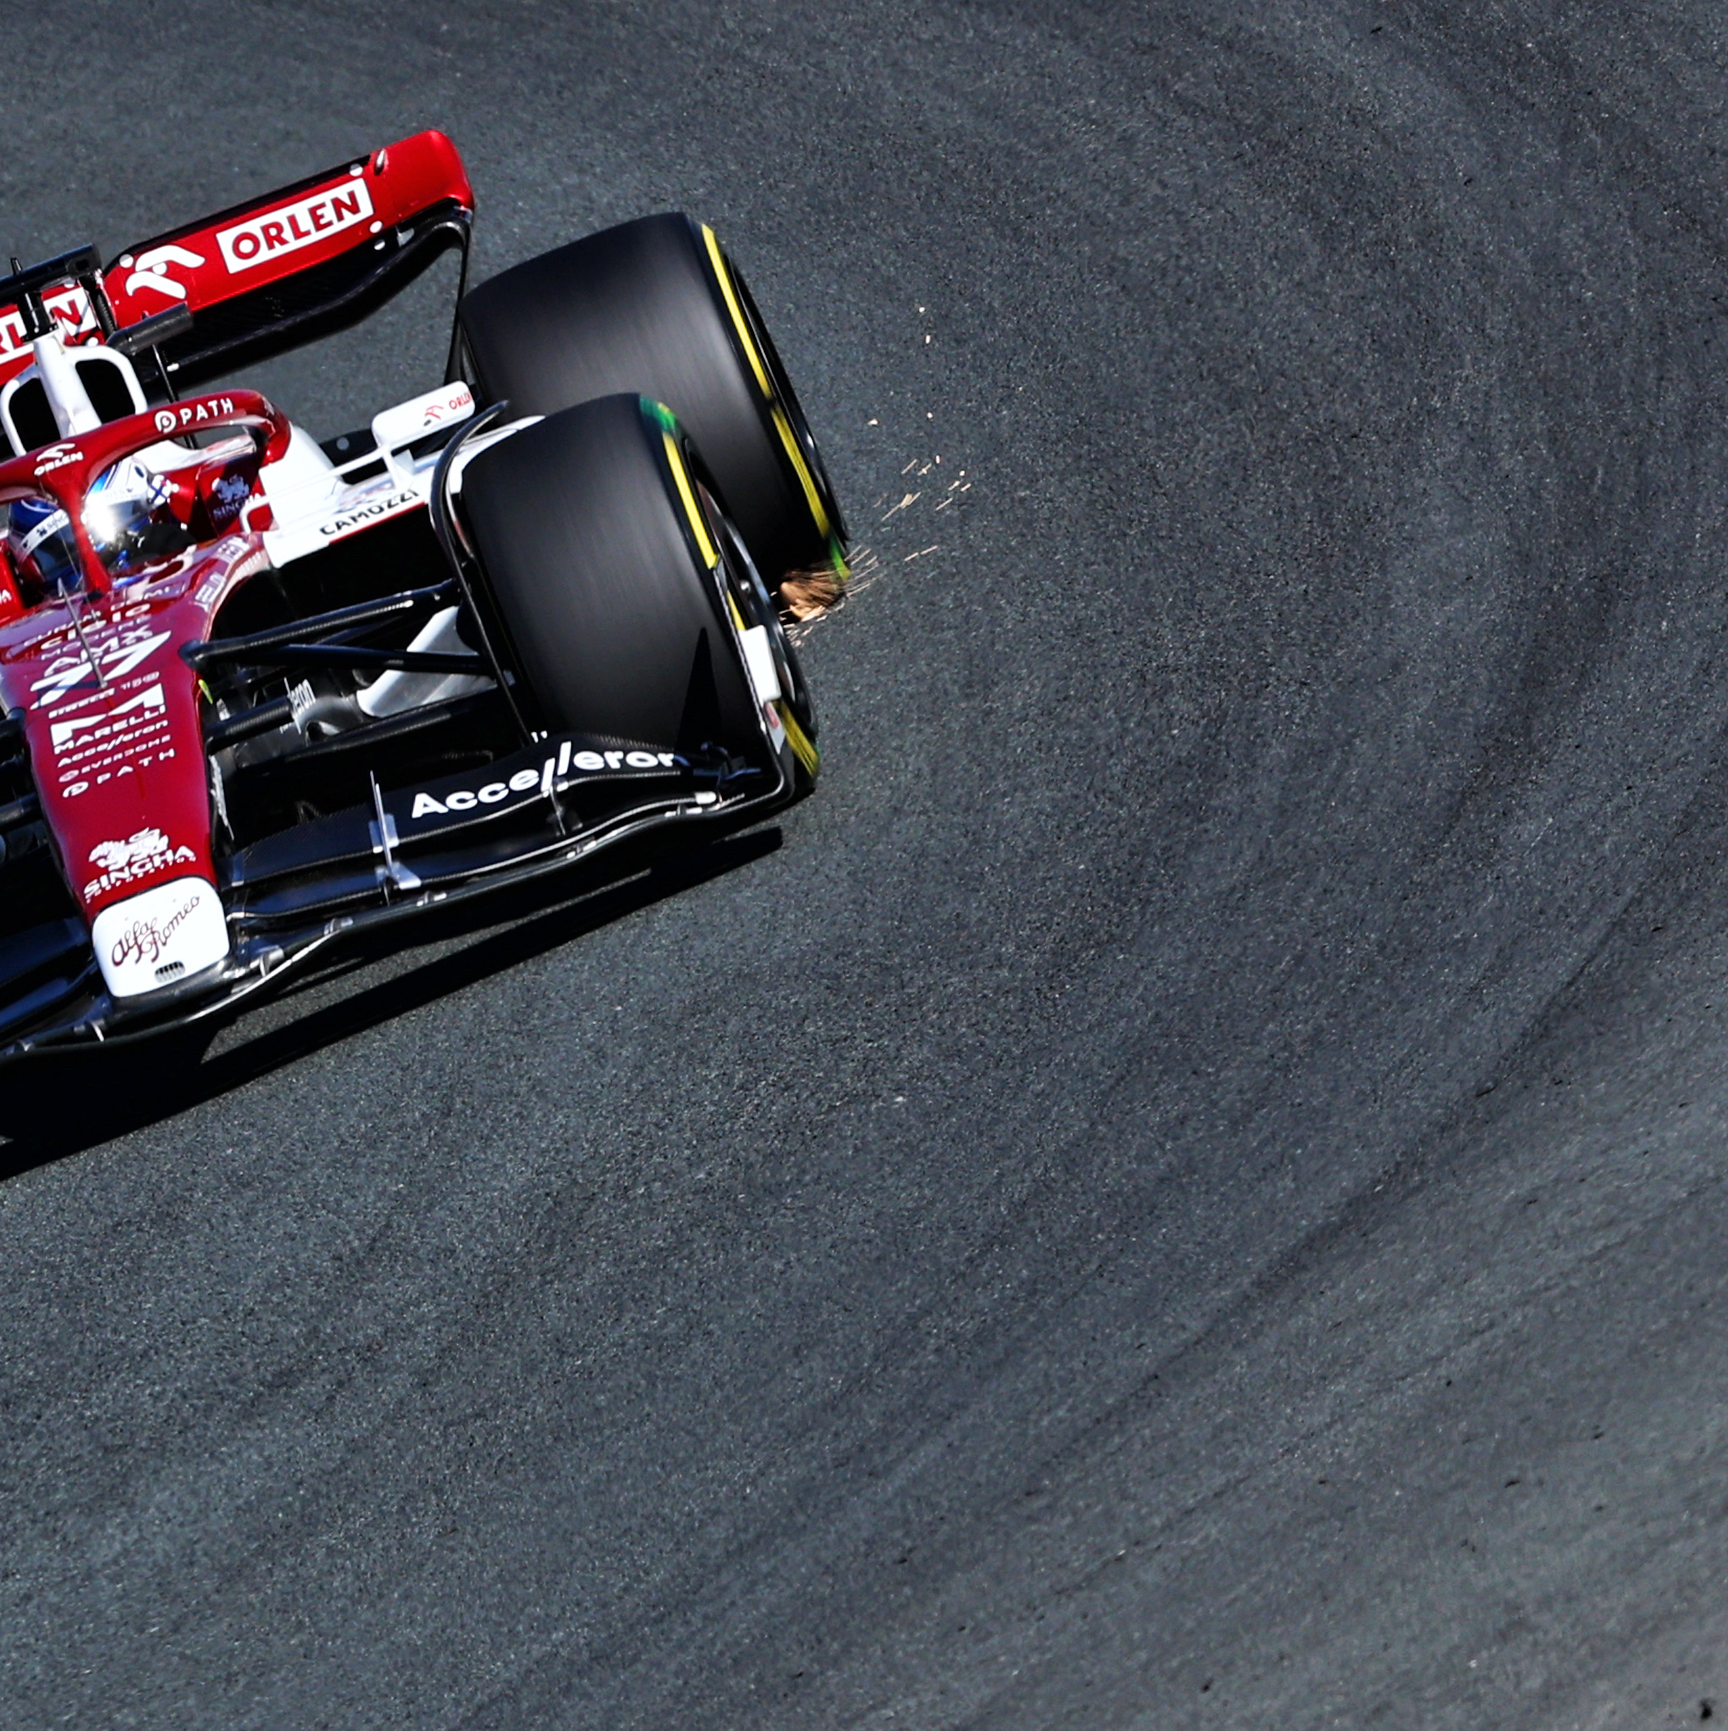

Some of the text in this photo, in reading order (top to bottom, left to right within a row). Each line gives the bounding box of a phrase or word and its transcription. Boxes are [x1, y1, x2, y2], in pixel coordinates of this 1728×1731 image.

[230, 190, 361, 260] ORLEN
[180, 397, 234, 425] PATH
[34, 450, 83, 476] ORLEN
[319, 489, 420, 535] CAMOZZI
[30, 630, 171, 710] 77
[44, 625, 154, 677] AMX
[54, 704, 167, 755] MARELLI
[57, 719, 169, 768] Accelleron
[97, 748, 176, 785] PATH
[412, 741, 690, 819] Accelleron
[84, 845, 196, 898] SINGHA
[141, 896, 201, 963] Romeo
